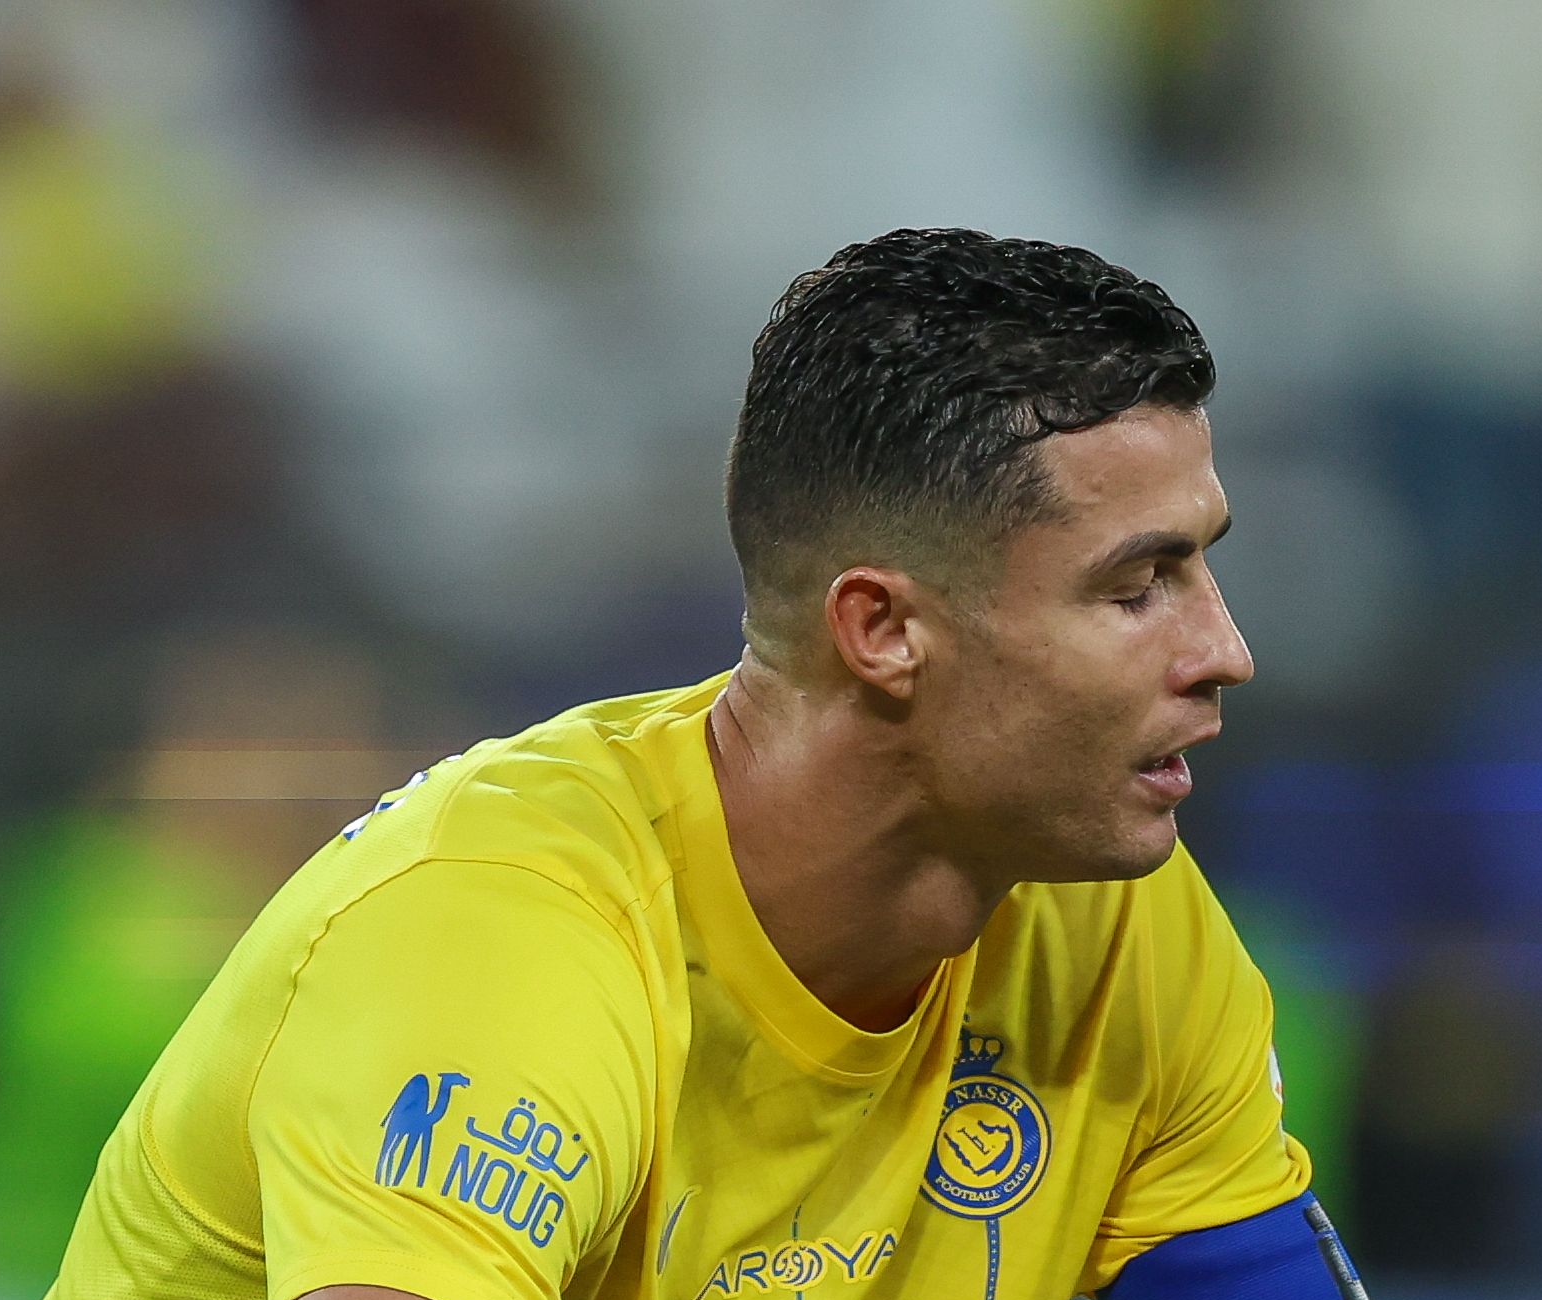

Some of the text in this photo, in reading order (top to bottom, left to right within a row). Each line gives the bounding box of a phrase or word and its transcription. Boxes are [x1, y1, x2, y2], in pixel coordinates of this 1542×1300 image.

[953, 1084, 1024, 1117] NASSR
[466, 1097, 590, 1182] نوق
[440, 1143, 565, 1249] NOUG
[935, 1162, 1032, 1201] FOOTBALL CLUB
